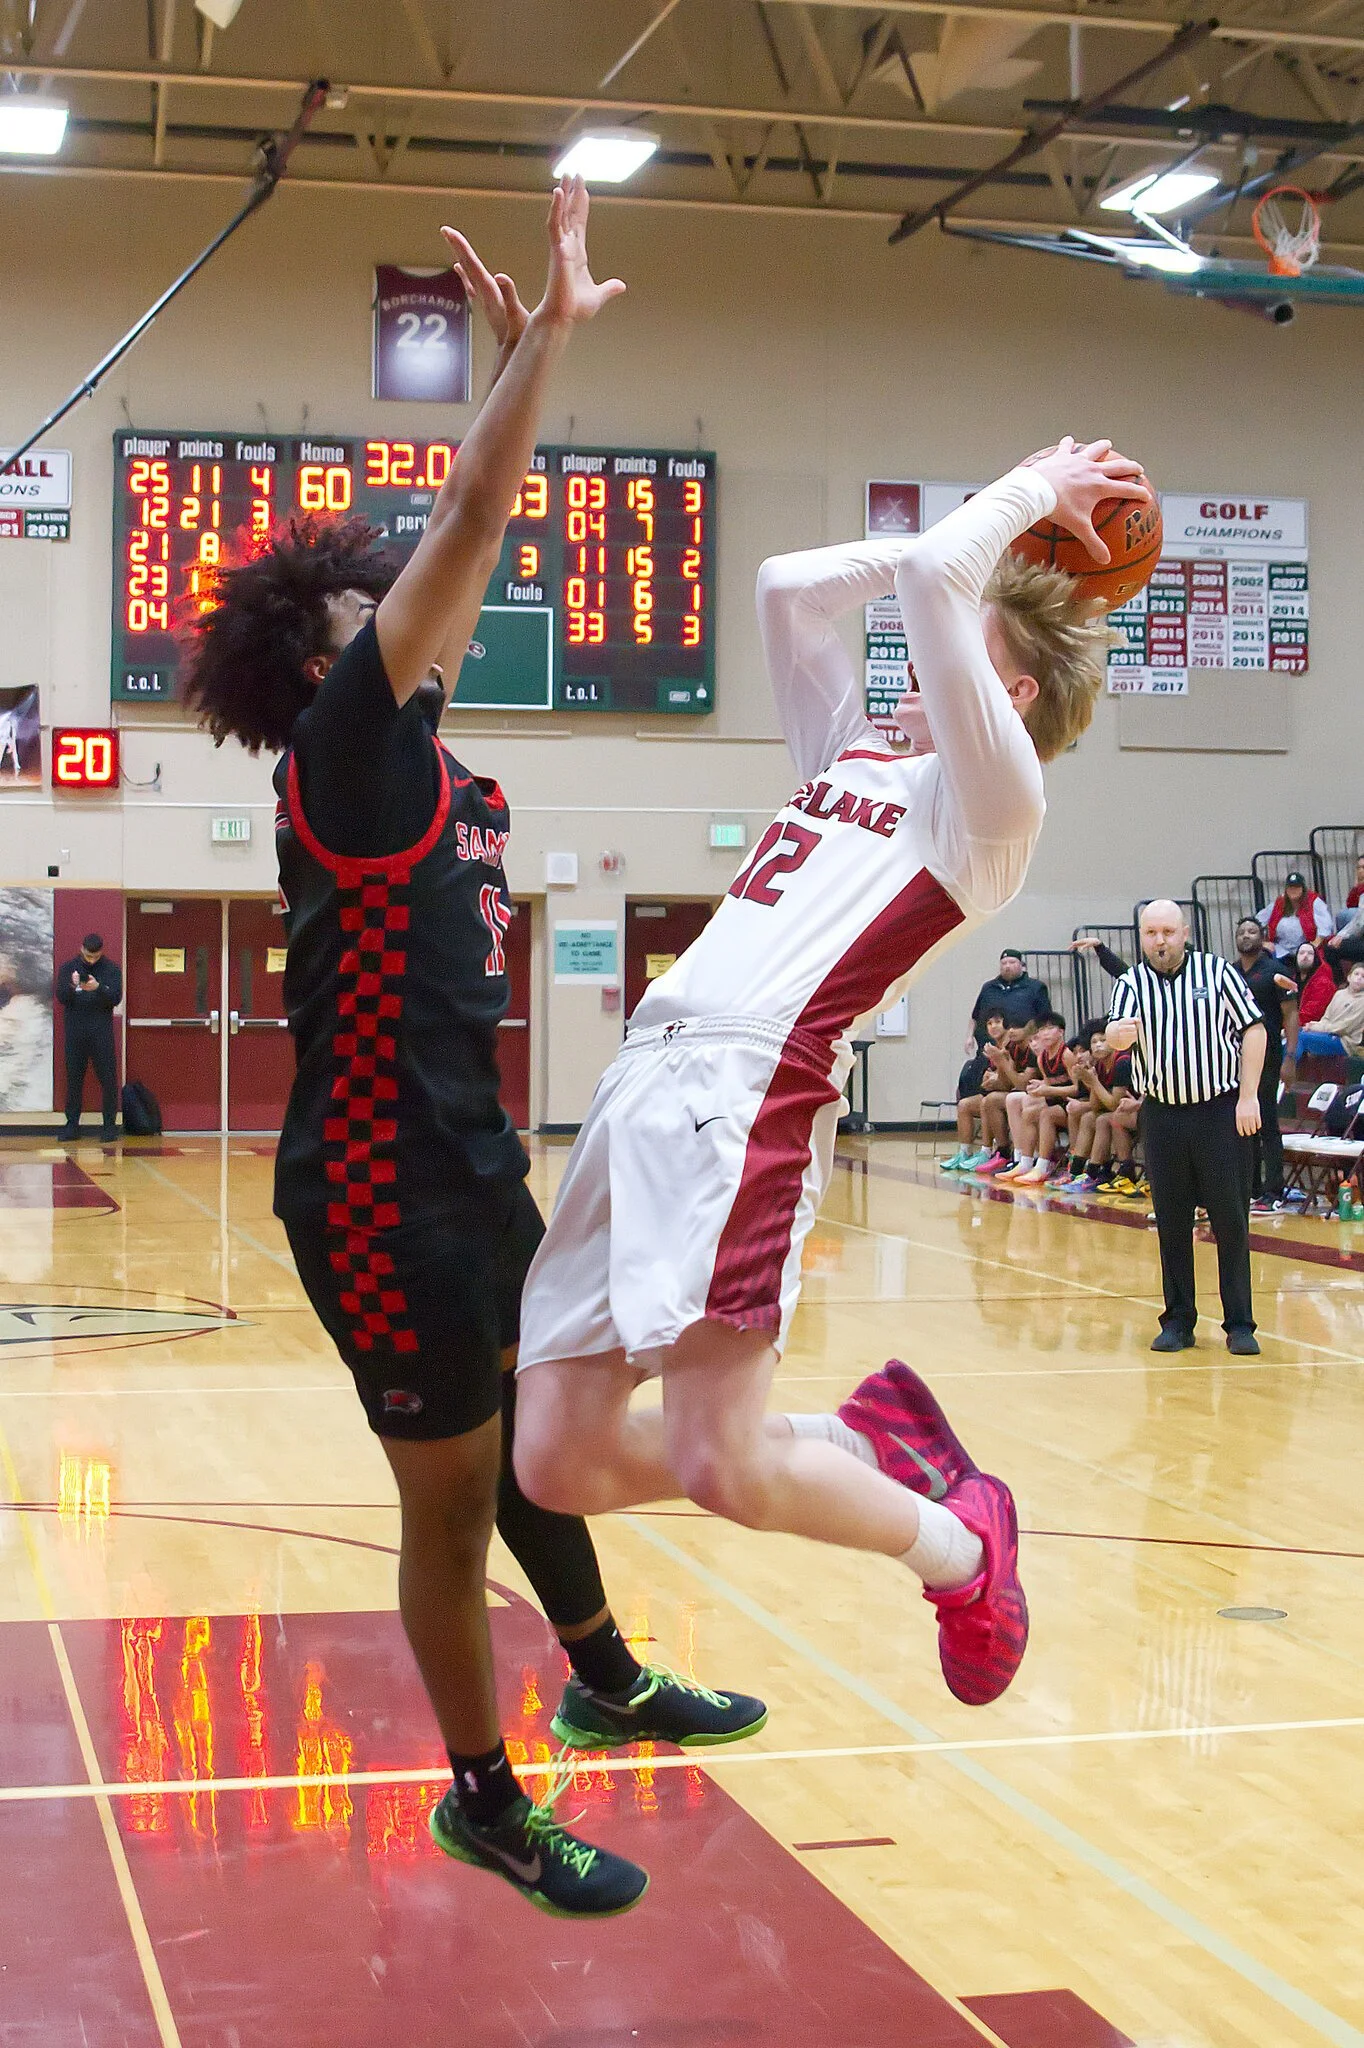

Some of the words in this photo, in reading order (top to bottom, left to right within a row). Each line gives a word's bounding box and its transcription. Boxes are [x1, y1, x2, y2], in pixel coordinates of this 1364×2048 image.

[381, 293, 462, 313] BORCHARDT
[397, 312, 448, 349] 22
[123, 438, 170, 457] player
[178, 440, 224, 459] points
[236, 442, 275, 461] fouls
[301, 443, 344, 462] Home
[366, 442, 451, 487] 32.0
[562, 454, 606, 473] player
[614, 457, 657, 475] points
[130, 462, 169, 493] 25
[192, 465, 220, 494] 11
[252, 467, 270, 495] 4
[300, 467, 351, 510] 60
[568, 477, 605, 509] 03
[628, 480, 653, 512] 15
[684, 482, 701, 512] 3
[142, 497, 169, 528] 12
[180, 497, 220, 529] 21
[1200, 502, 1268, 520] GOLF
[27, 524, 67, 538] 2021
[567, 511, 605, 541] 04
[636, 513, 653, 541] 7
[693, 517, 701, 544] 1
[1184, 525, 1283, 540] CHAMPIONS
[130, 531, 168, 562] 21
[200, 532, 219, 564] 8
[520, 545, 538, 578] 3
[579, 546, 605, 573] 11
[627, 546, 653, 578] 15
[682, 550, 700, 578] 2
[129, 565, 168, 597] 23
[1232, 577, 1264, 587] 2002
[567, 578, 605, 609] 01
[634, 580, 652, 612] 6
[692, 584, 700, 610] 1
[128, 599, 168, 630] 04
[1191, 601, 1224, 613] 2014
[1232, 605, 1263, 614] 2014
[1273, 606, 1304, 616] 2014
[568, 612, 604, 643] 33
[634, 614, 652, 644] 5
[684, 616, 700, 645] 3
[1233, 631, 1264, 641] 2015
[1233, 657, 1264, 667] 2016
[1273, 659, 1305, 670] 2017
[870, 675, 904, 686] 2015
[1111, 682, 1144, 692] 2017
[1152, 683, 1184, 692] 2017
[869, 702, 897, 714] 201
[58, 737, 111, 781] 20
[220, 821, 243, 839] EXIT
[728, 821, 822, 907] 12
